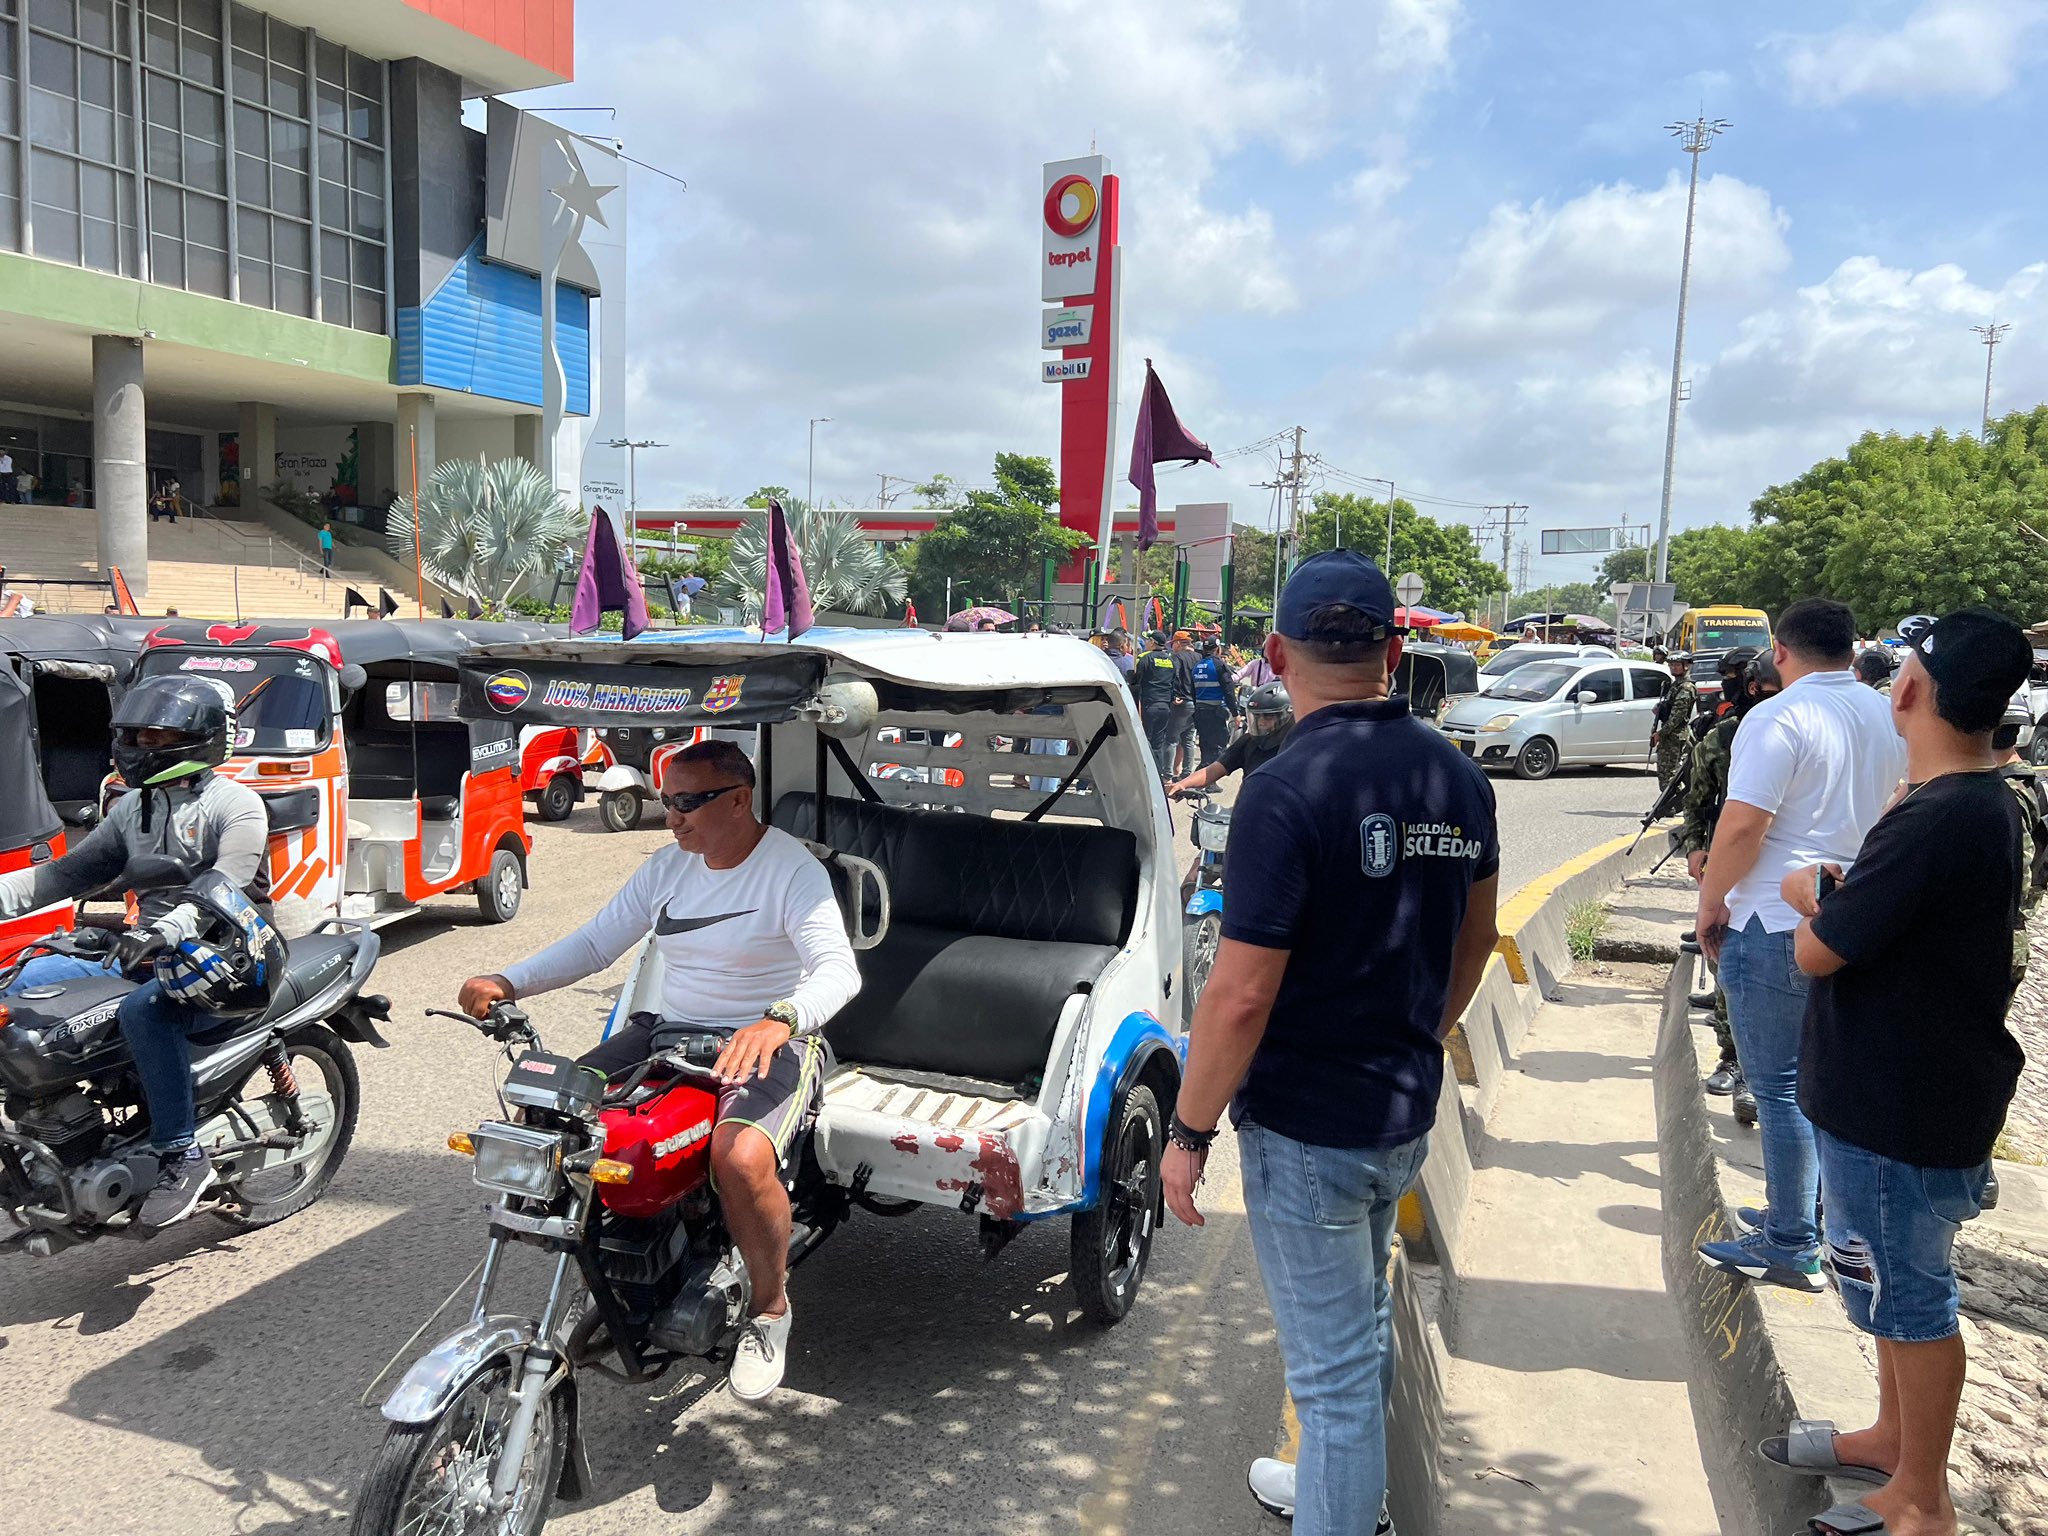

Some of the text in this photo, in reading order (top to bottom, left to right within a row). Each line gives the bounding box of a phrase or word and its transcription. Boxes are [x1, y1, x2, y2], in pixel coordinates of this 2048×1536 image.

[1048, 247, 1091, 267] terpel
[1048, 322, 1083, 342] gazel
[1046, 362, 1086, 377] Mobil 1
[277, 457, 327, 469] Gran Plaza
[583, 485, 601, 493] Gran
[543, 680, 691, 712] 100% MARACUCHO
[54, 1008, 116, 1041] BOXER
[651, 1118, 712, 1159] SUZUKI
